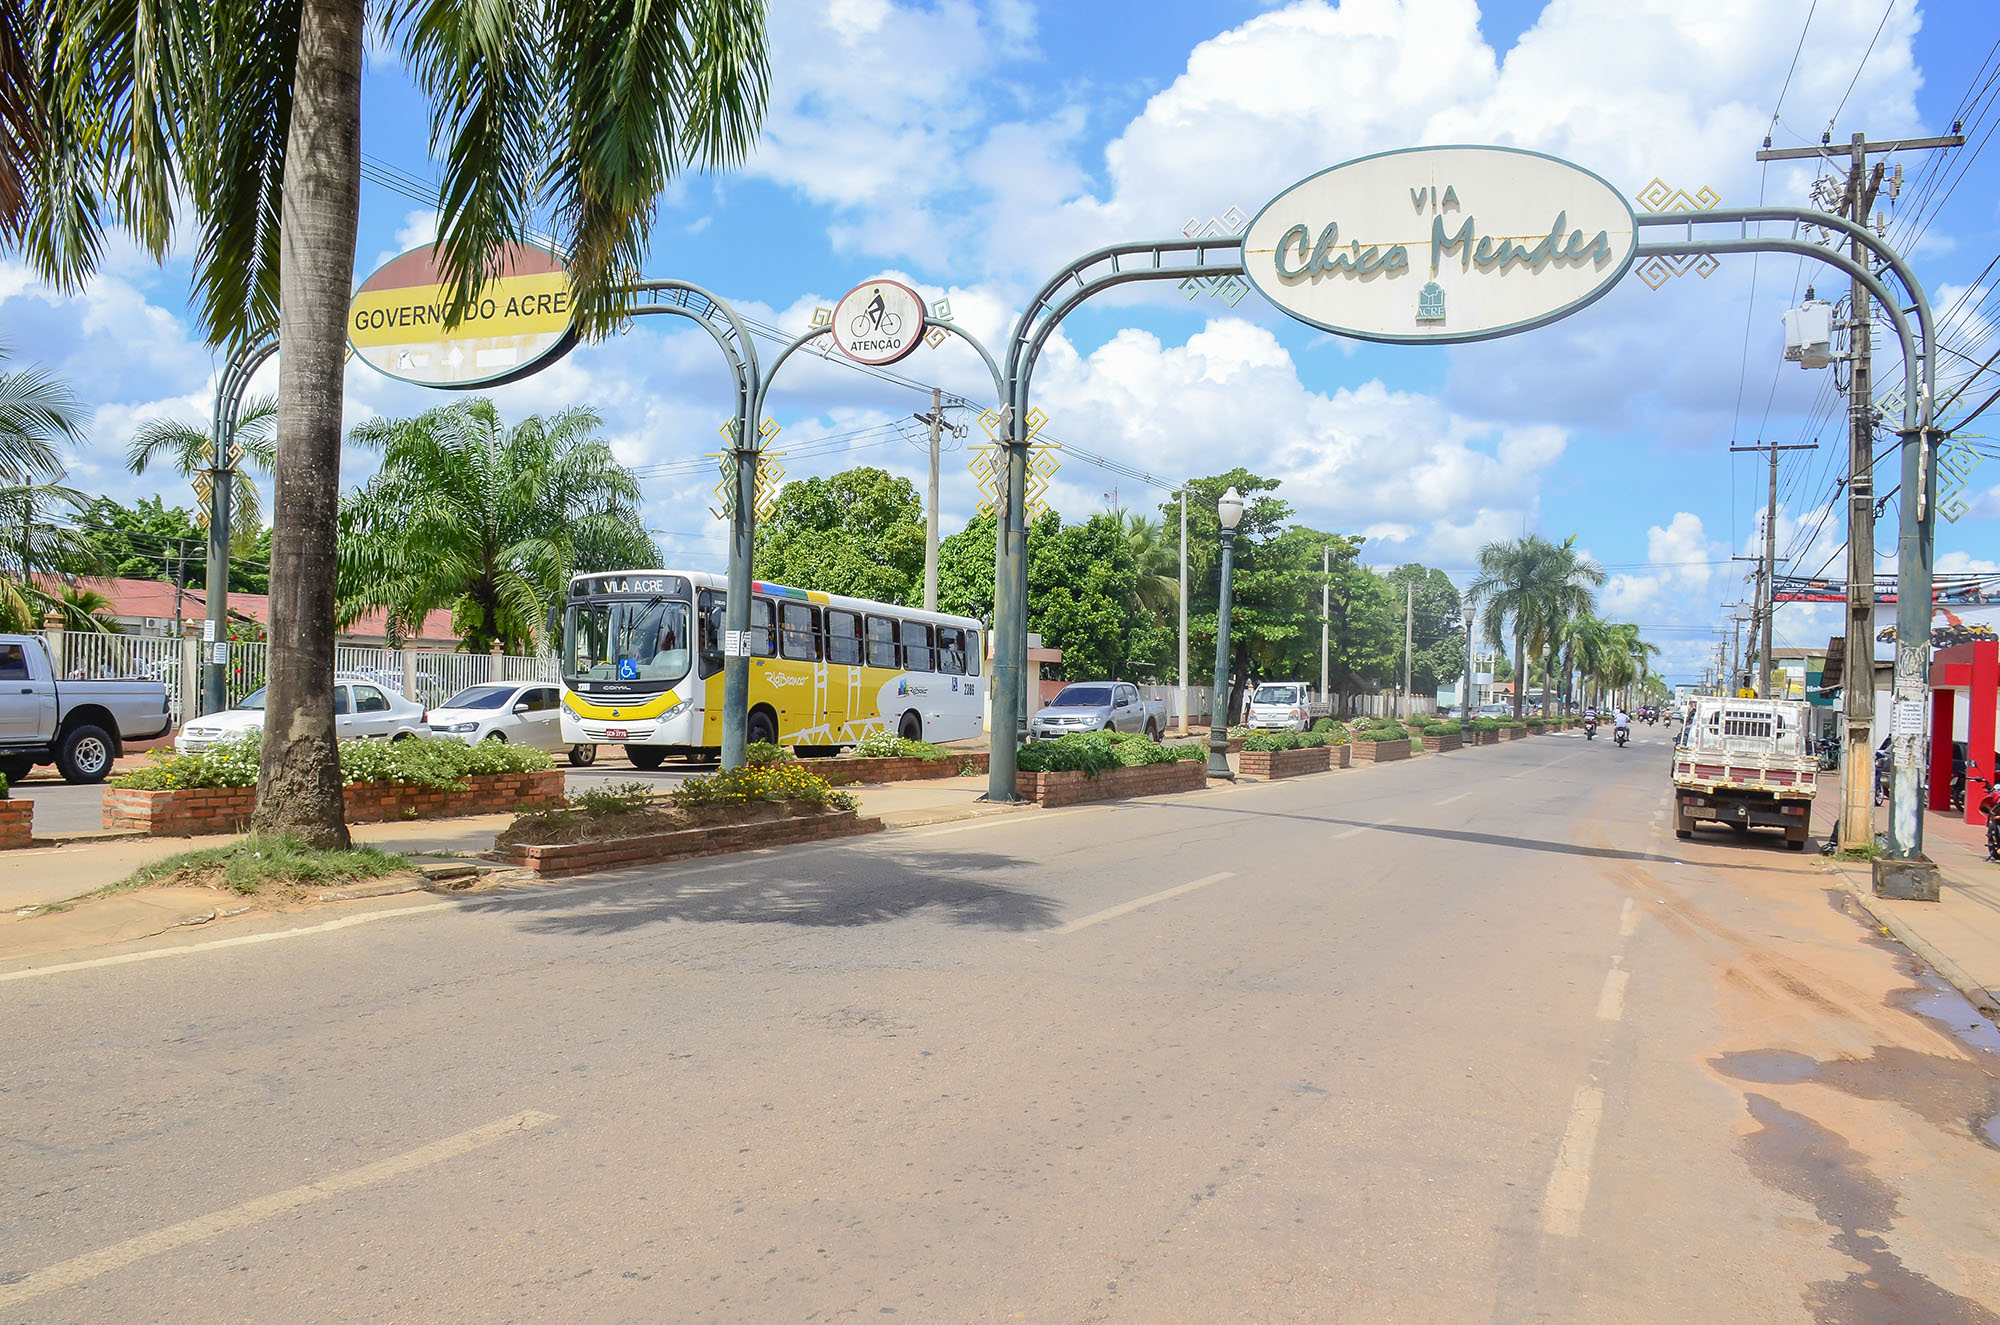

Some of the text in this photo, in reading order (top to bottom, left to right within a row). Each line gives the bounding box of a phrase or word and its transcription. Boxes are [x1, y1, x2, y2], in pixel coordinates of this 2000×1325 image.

[1409, 185, 1460, 207] VIA
[1274, 210, 1612, 278] Chico Mendes
[464, 298, 496, 321] DO
[503, 292, 567, 318] ACRE
[1418, 306, 1445, 317] ACRE
[850, 337, 901, 353] ATENÇÃO
[603, 579, 665, 593] VILA ACRE
